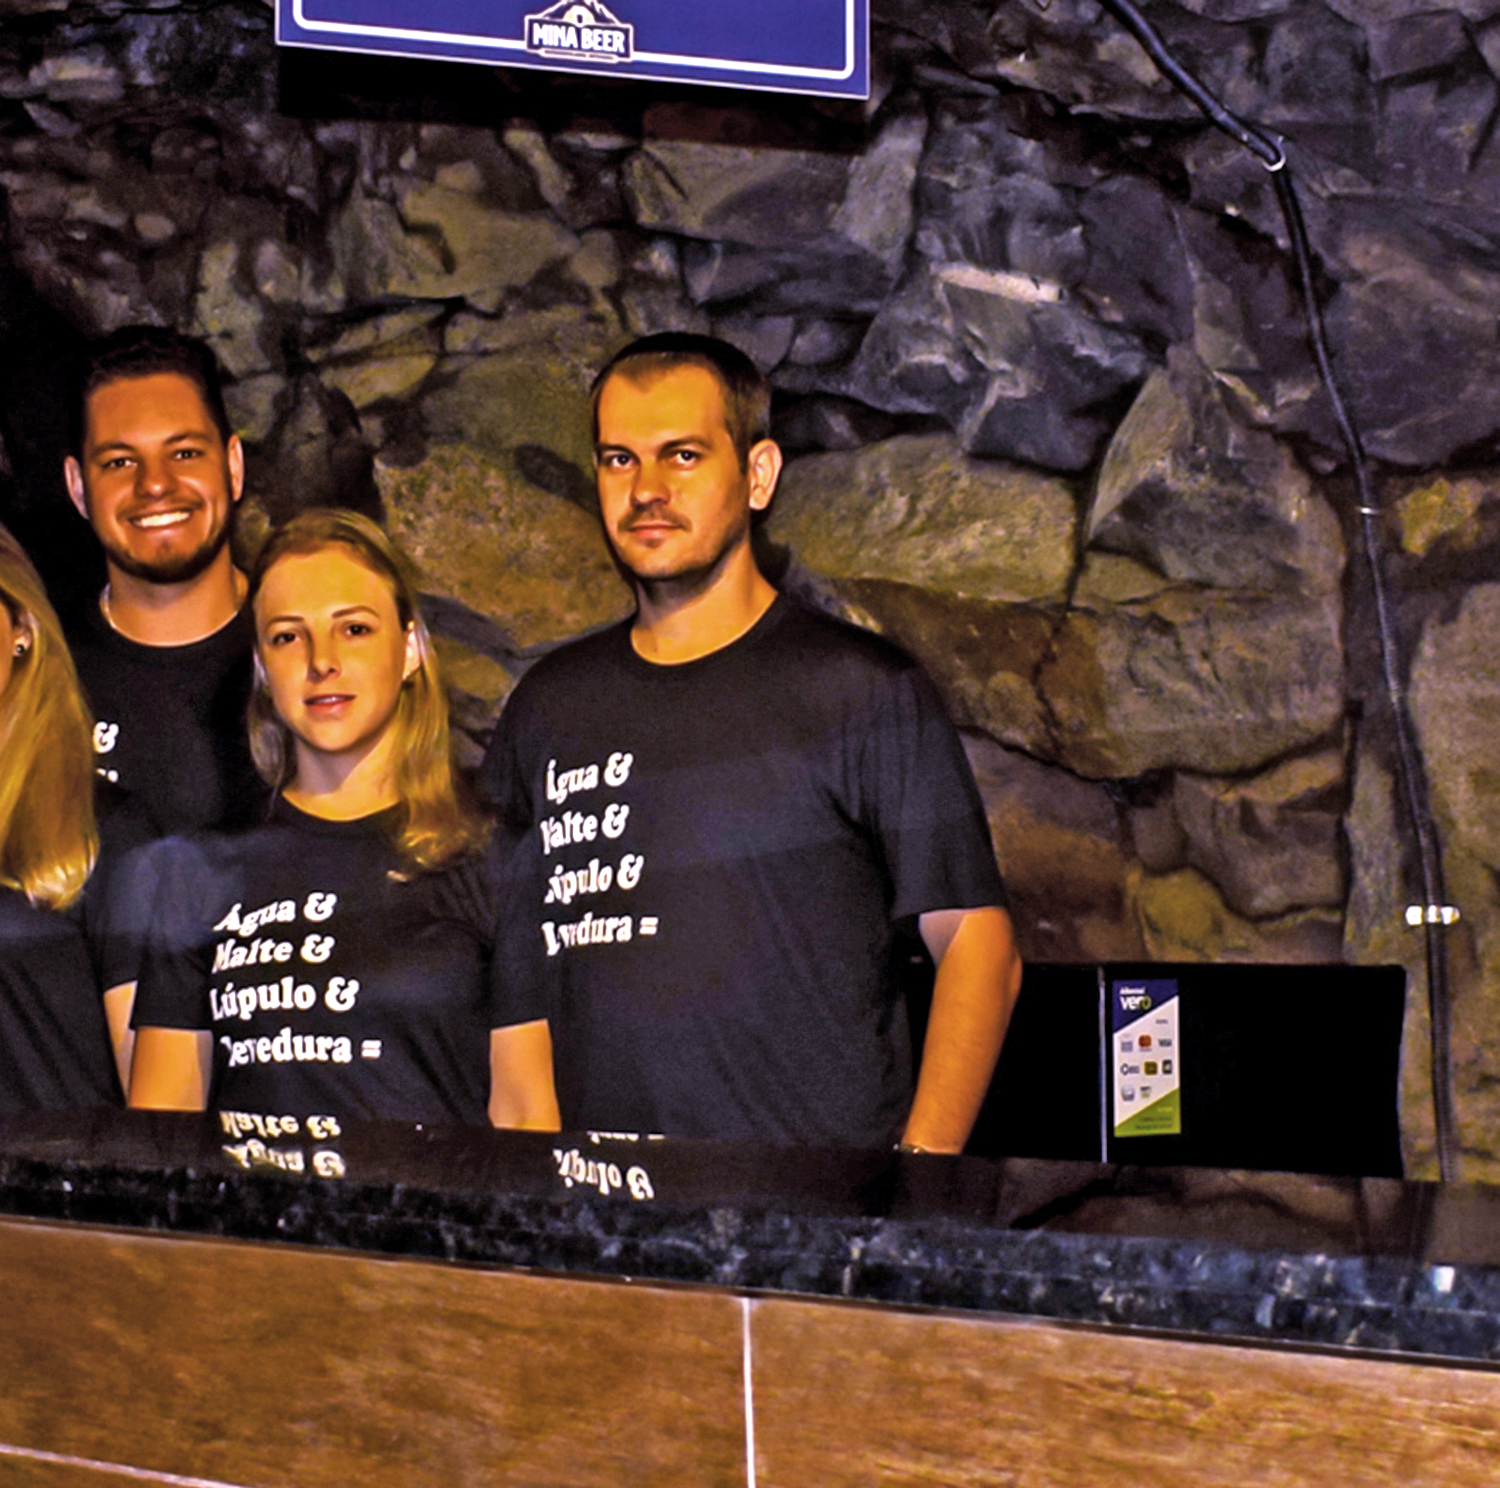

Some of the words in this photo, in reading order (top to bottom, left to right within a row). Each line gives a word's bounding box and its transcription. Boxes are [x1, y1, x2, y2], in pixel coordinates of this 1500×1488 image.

[533, 22, 578, 49] MINA
[581, 27, 625, 54] BEER
[93, 721, 119, 753] &
[604, 752, 633, 787] &
[602, 803, 630, 839] &
[617, 853, 644, 890] &
[213, 900, 296, 937] Água
[303, 892, 338, 922] &
[639, 917, 659, 935] =
[211, 938, 294, 974] Malte
[300, 933, 335, 964] &
[209, 976, 317, 1021] Lúpulo
[325, 976, 360, 1013] &
[361, 1039, 382, 1058] =
